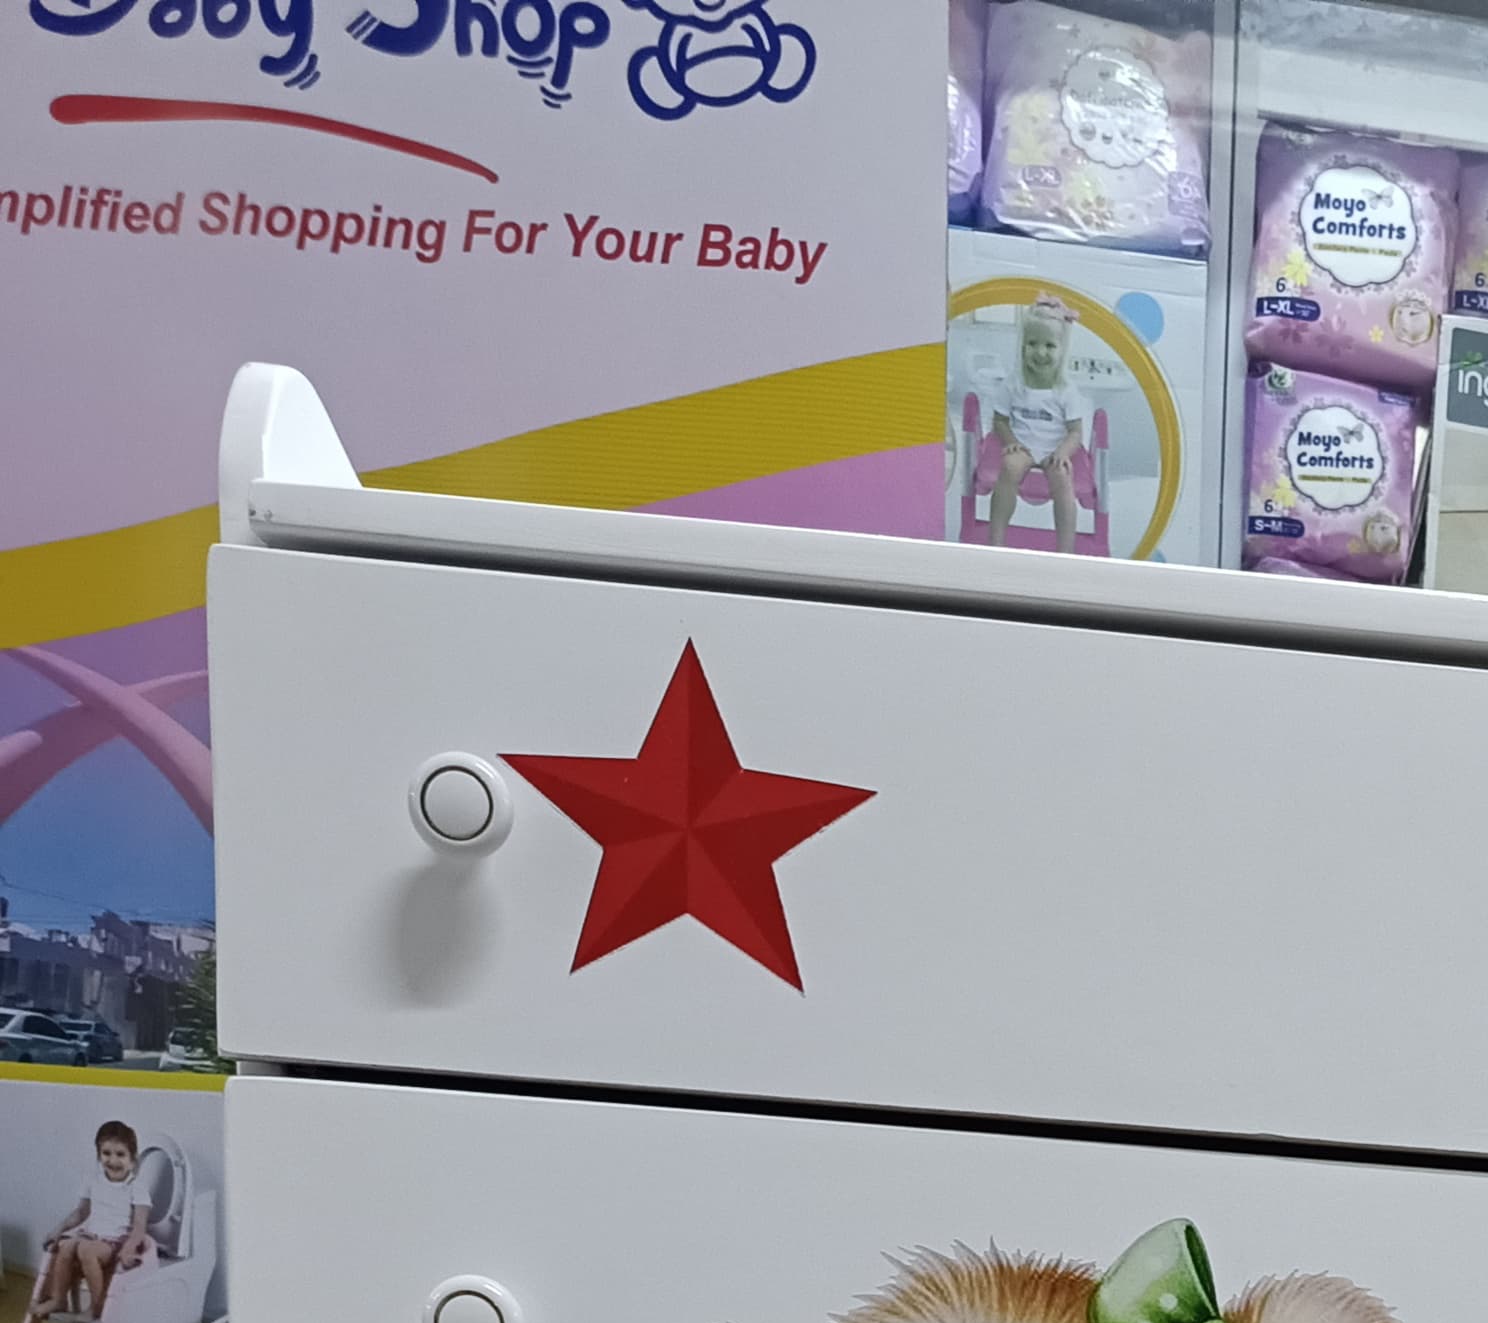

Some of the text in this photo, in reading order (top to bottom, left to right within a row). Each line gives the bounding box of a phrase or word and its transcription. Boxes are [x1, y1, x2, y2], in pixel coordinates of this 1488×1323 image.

[28, 0, 314, 76] aby
[1313, 192, 1367, 218] Moyo
[198, 189, 446, 264] Shopping
[462, 209, 549, 255] For
[563, 212, 685, 265] Your
[696, 223, 829, 286] Baby
[1311, 216, 1407, 240] Comforts
[1275, 276, 1287, 293] 6
[1474, 272, 1486, 288] 6
[1297, 431, 1342, 452] Moyo
[1296, 451, 1375, 470] Comforts
[1264, 498, 1274, 513] 6
